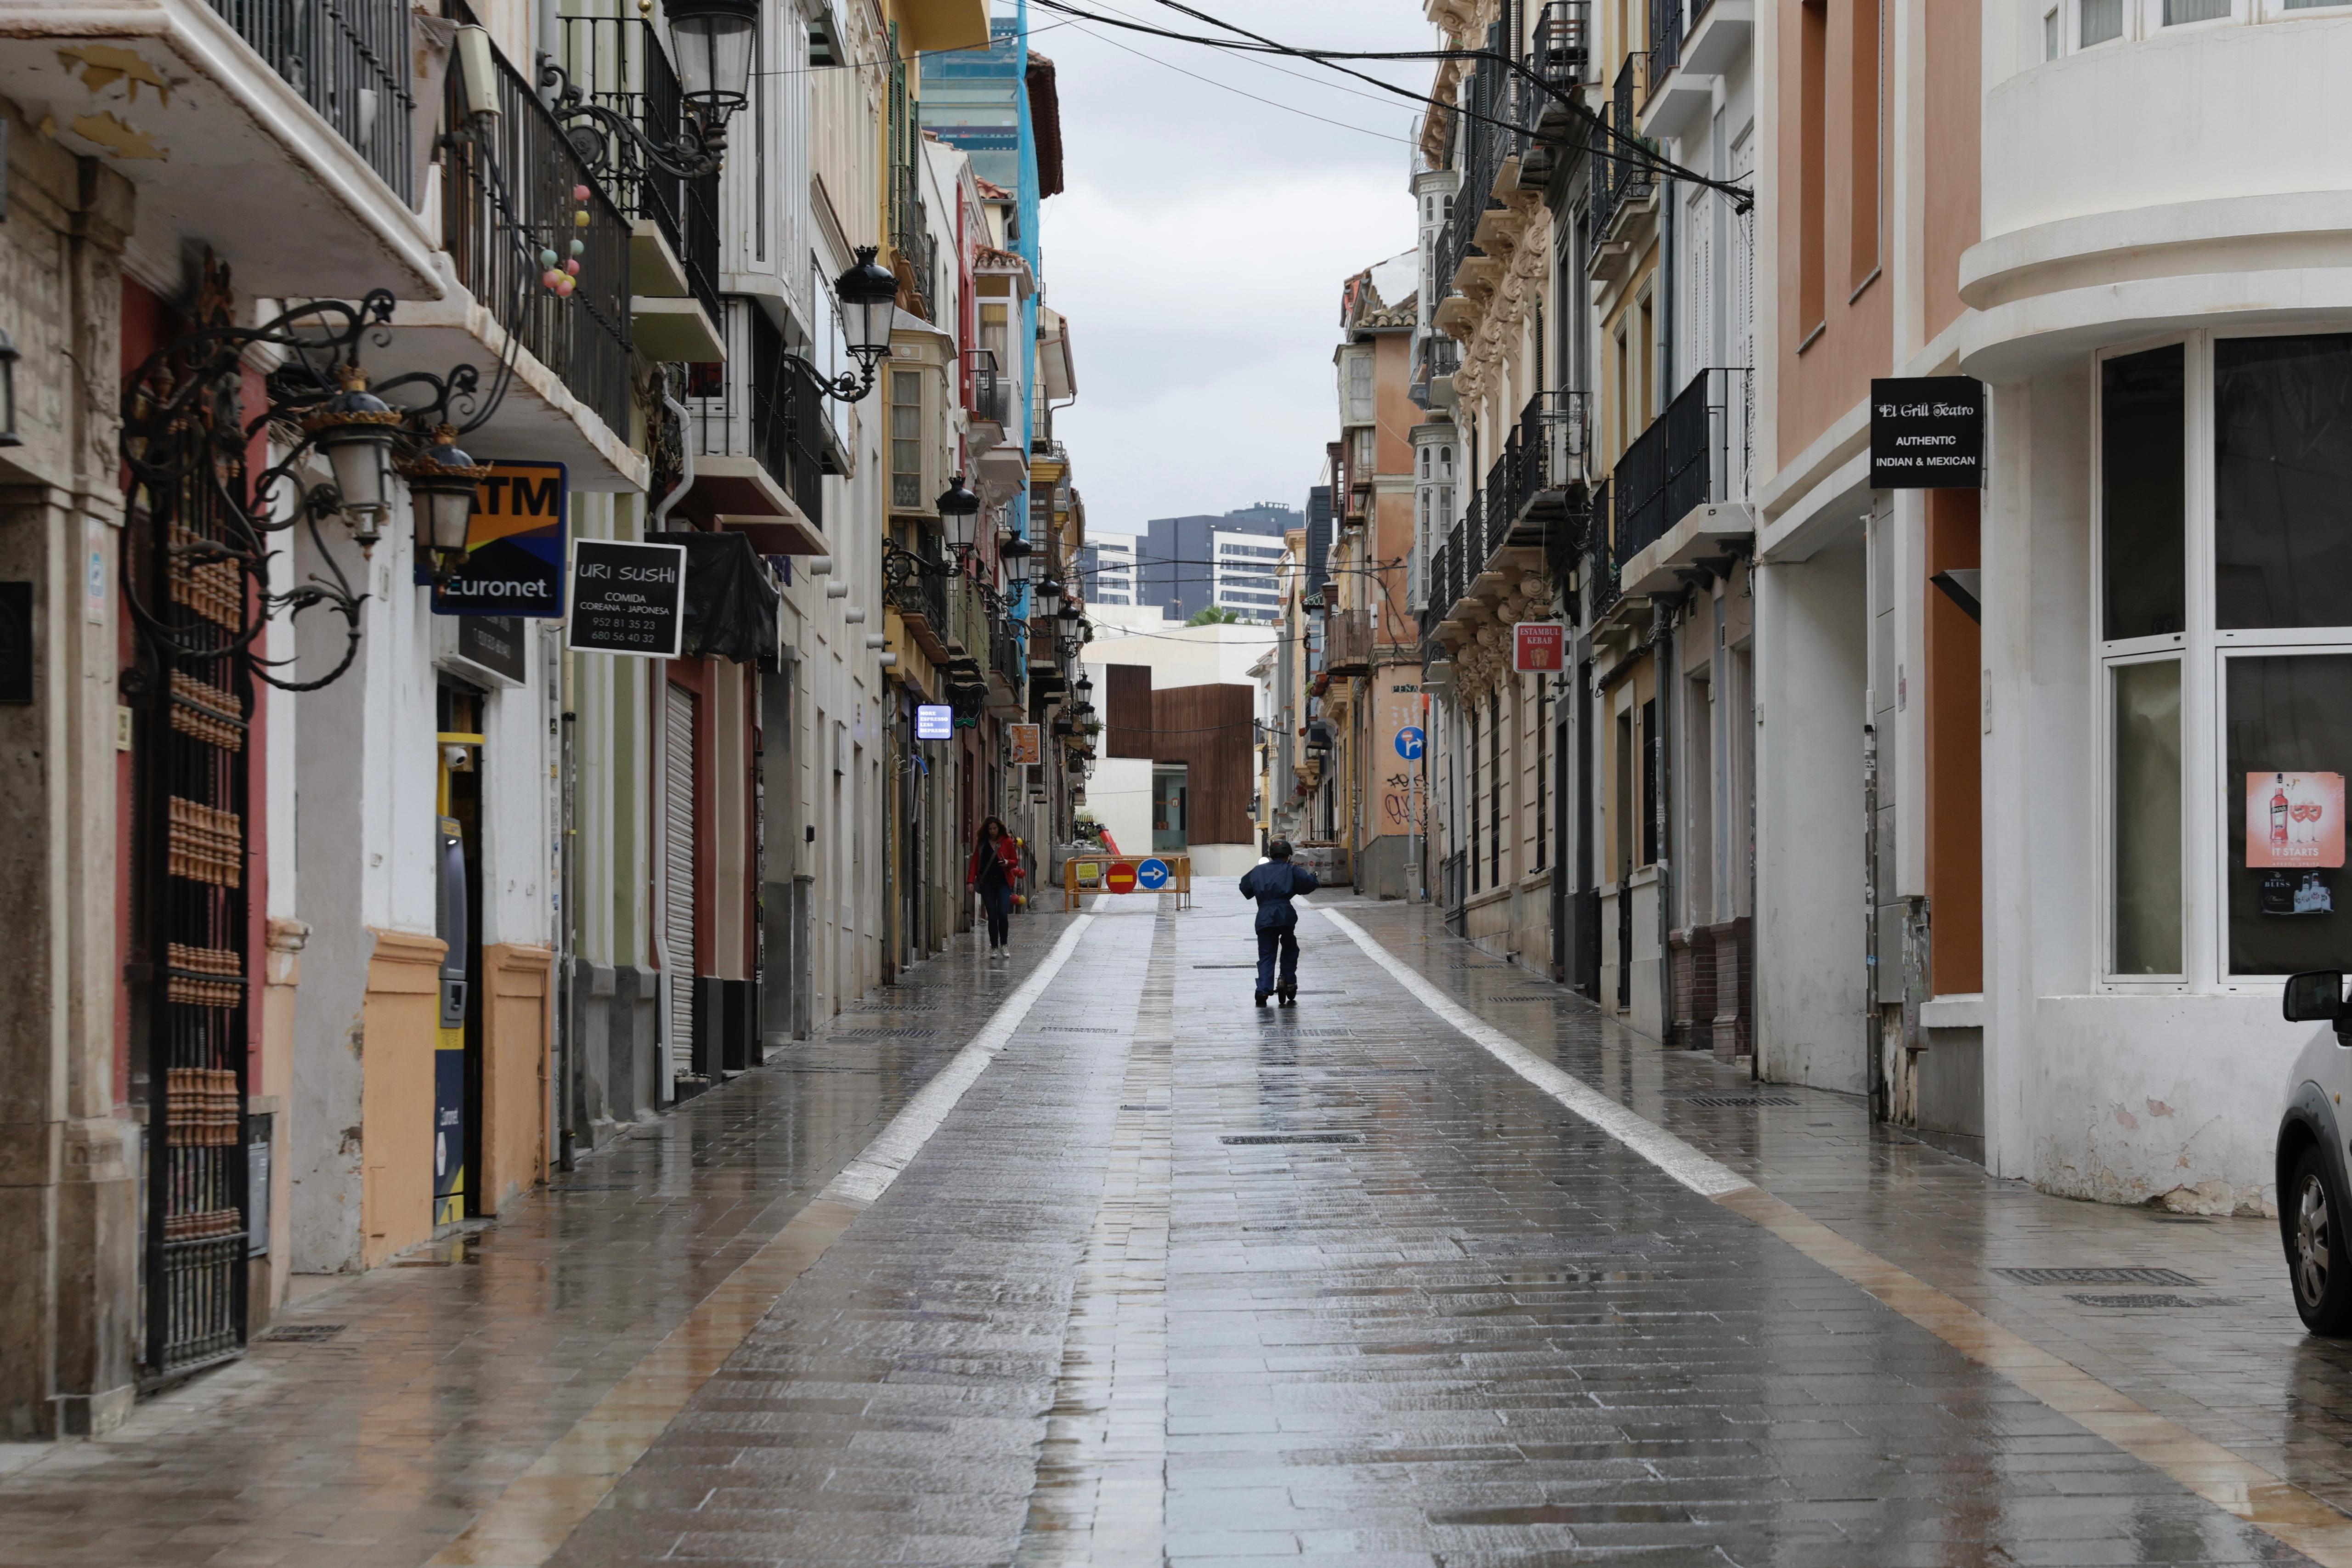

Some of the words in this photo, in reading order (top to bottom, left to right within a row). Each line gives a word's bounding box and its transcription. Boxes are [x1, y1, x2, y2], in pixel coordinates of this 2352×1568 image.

[1879, 404, 1897, 417] El
[1900, 404, 1929, 417] Grill
[1933, 403, 1974, 417] Teatro
[1896, 436, 1956, 446] AUTHENTIC
[1876, 458, 1912, 467] INDIAN
[1916, 458, 1923, 466] &
[1927, 457, 1975, 466] MEXICAN
[470, 476, 559, 516] TM
[579, 564, 611, 579] URI
[619, 566, 675, 583] SUSHI
[605, 592, 646, 603] COMIDA
[579, 602, 621, 612] COREANA
[628, 606, 670, 615] JAPONESA
[593, 617, 611, 627] 952
[613, 619, 625, 627] 81
[628, 620, 641, 628] 35
[643, 621, 656, 630] 23
[591, 631, 610, 640] 680
[612, 633, 625, 641] 56
[627, 634, 640, 642] 40
[643, 634, 655, 643] 32
[1391, 684, 1419, 693] PEÑA
